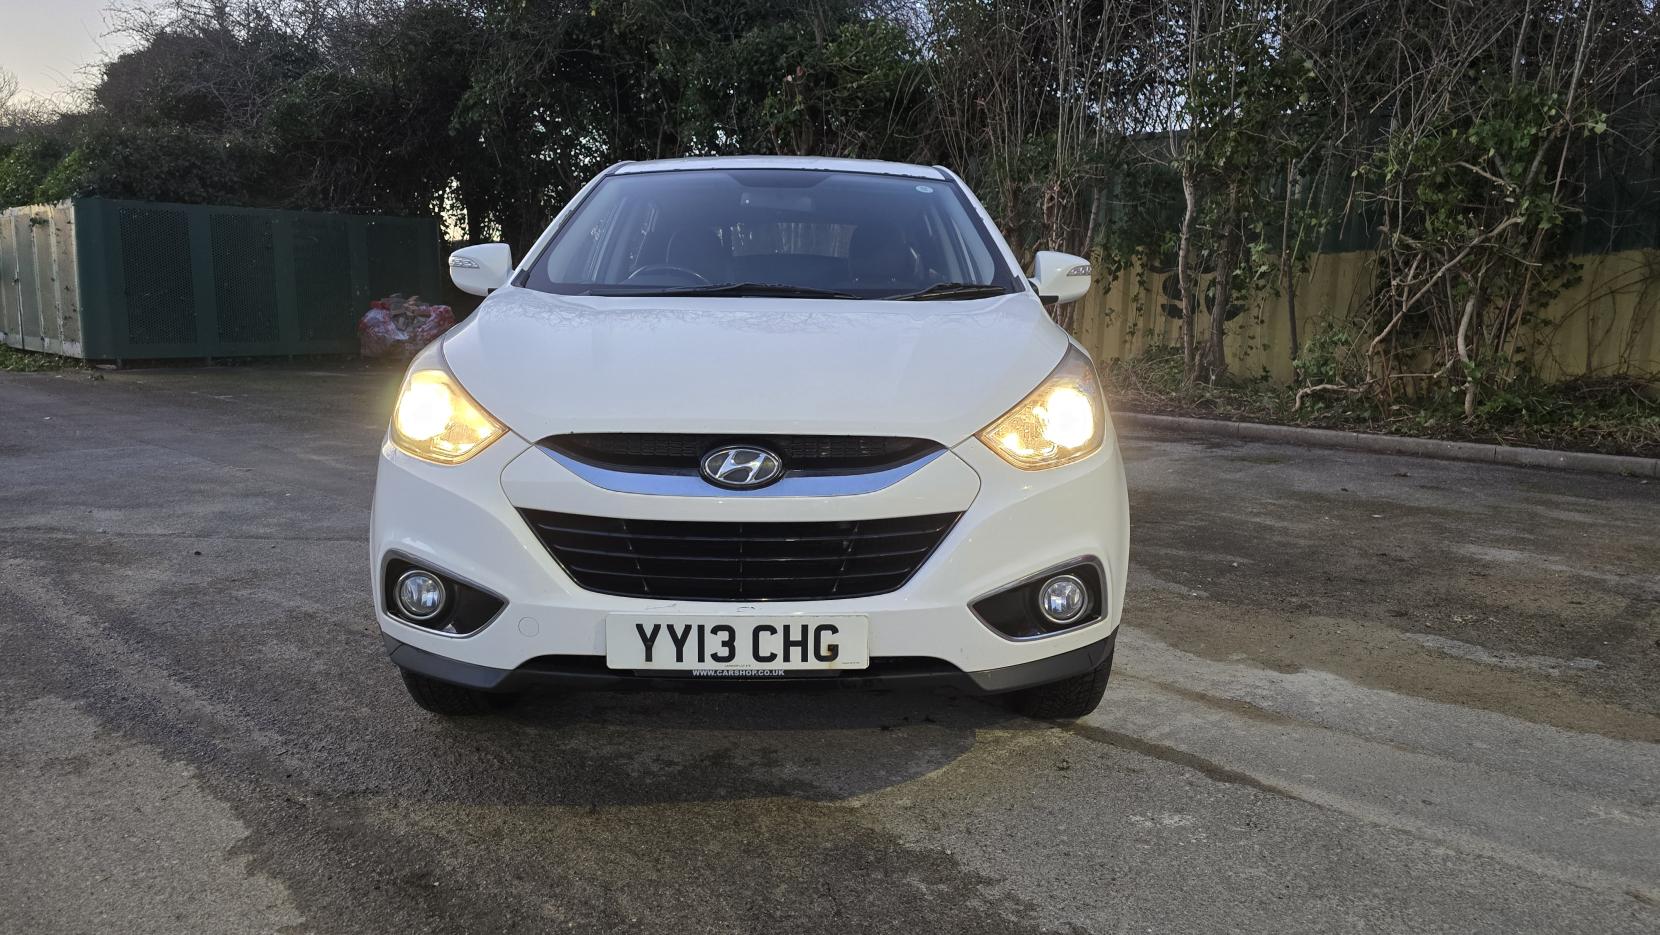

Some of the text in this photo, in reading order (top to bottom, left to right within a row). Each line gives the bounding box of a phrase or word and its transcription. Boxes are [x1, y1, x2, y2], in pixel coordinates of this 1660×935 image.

[635, 623, 839, 663] YY13 CHG
[692, 669, 785, 677] WWW.CARSHOP.CO.UK
